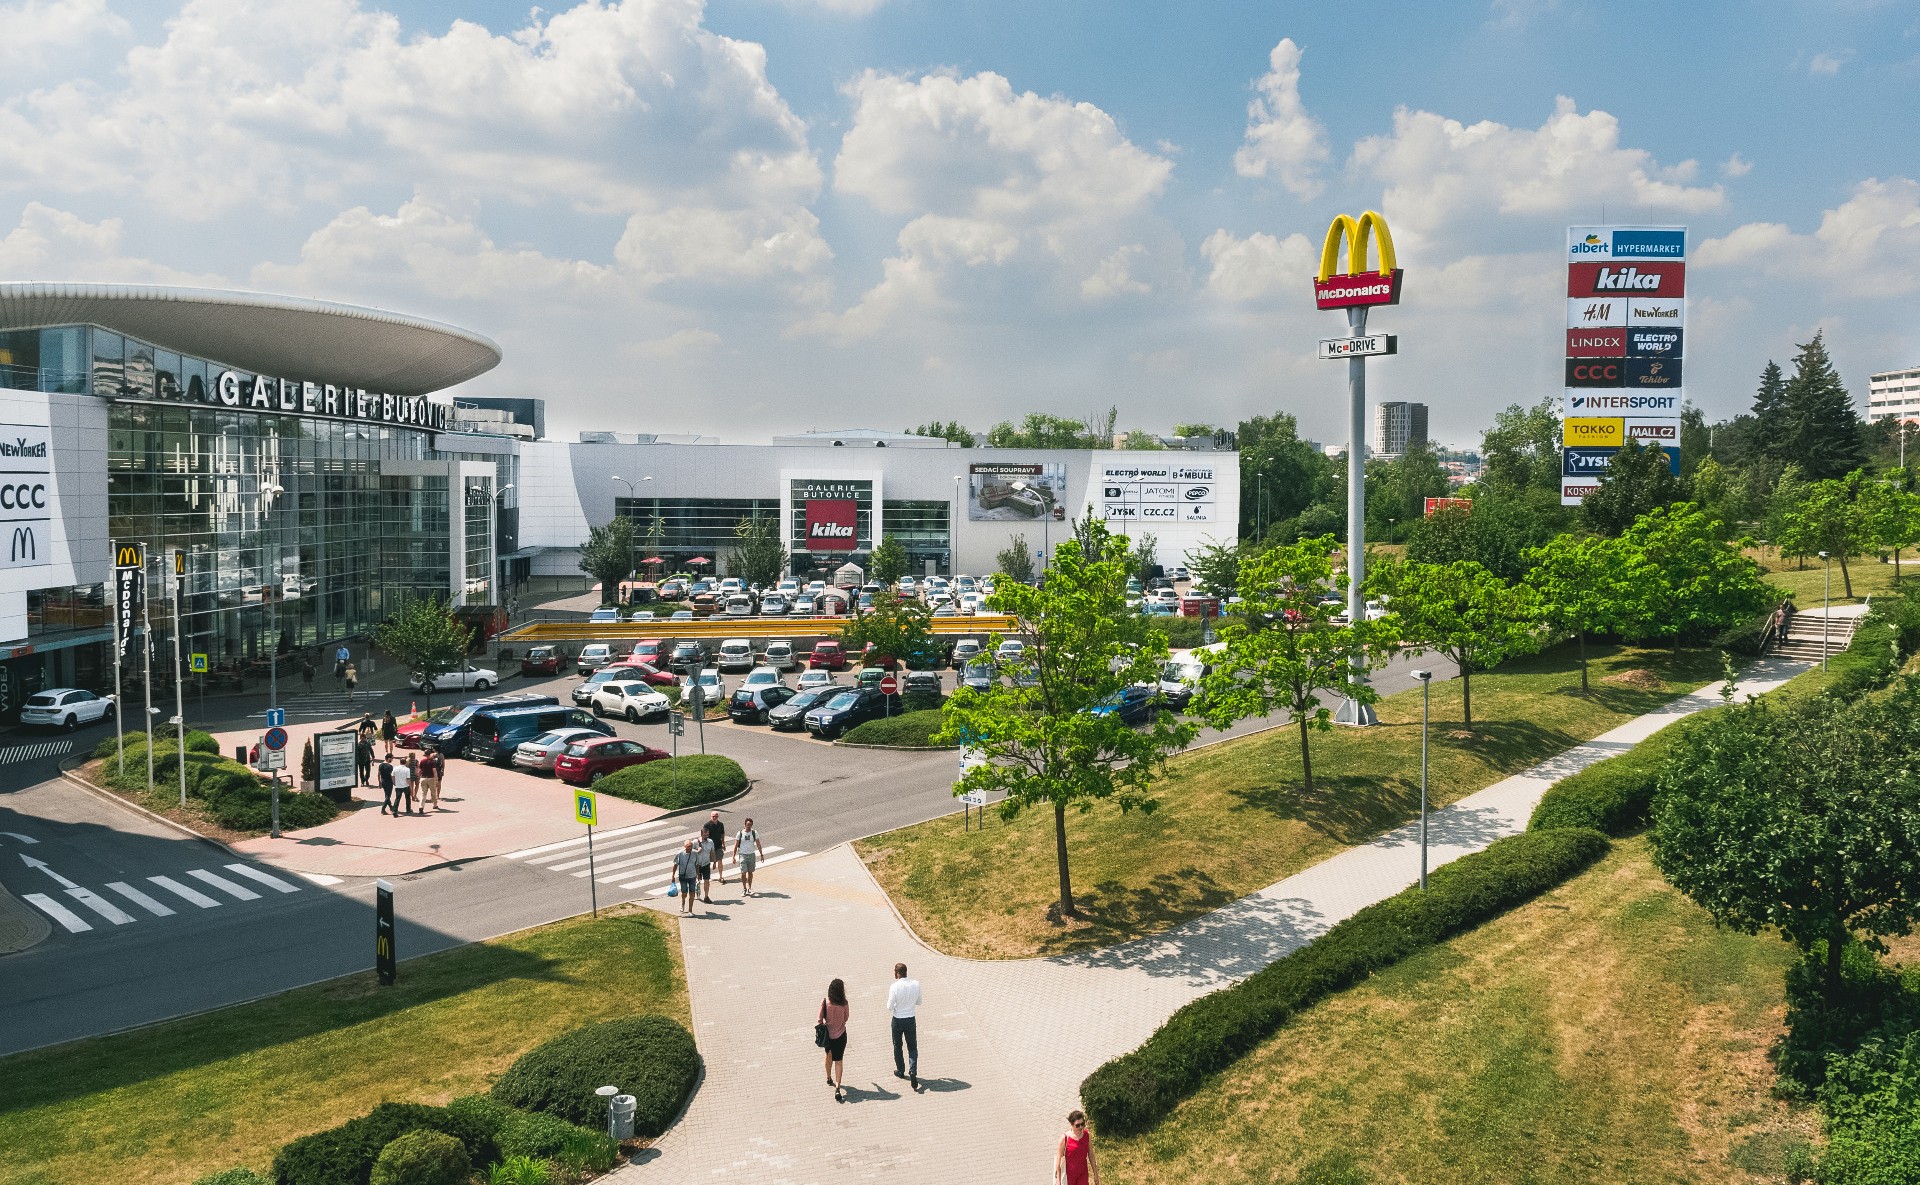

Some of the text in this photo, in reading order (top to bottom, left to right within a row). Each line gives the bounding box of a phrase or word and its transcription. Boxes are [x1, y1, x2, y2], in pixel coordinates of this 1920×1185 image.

[1571, 242, 1681, 253] albert HYPERMARKET
[1595, 267, 1661, 290] kika
[1318, 284, 1390, 300] McDonald's
[1583, 303, 1611, 321] H&M
[1571, 337, 1620, 348] LINDEX
[1633, 333, 1677, 342] ELECTRO
[1637, 342, 1672, 351] WORLD
[1573, 365, 1617, 380] CCC
[1639, 375, 1670, 384] Tchibo
[219, 371, 447, 429] GALERIE BUTOVIC
[1586, 397, 1675, 409] INTERSPORT
[1631, 427, 1674, 438] MALL.CZ
[0, 484, 45, 509] CCC
[803, 491, 860, 499] BUTOVICE
[1112, 508, 1136, 516] JYSK
[1144, 508, 1175, 516] CZC.CZ
[811, 522, 854, 537] kika
